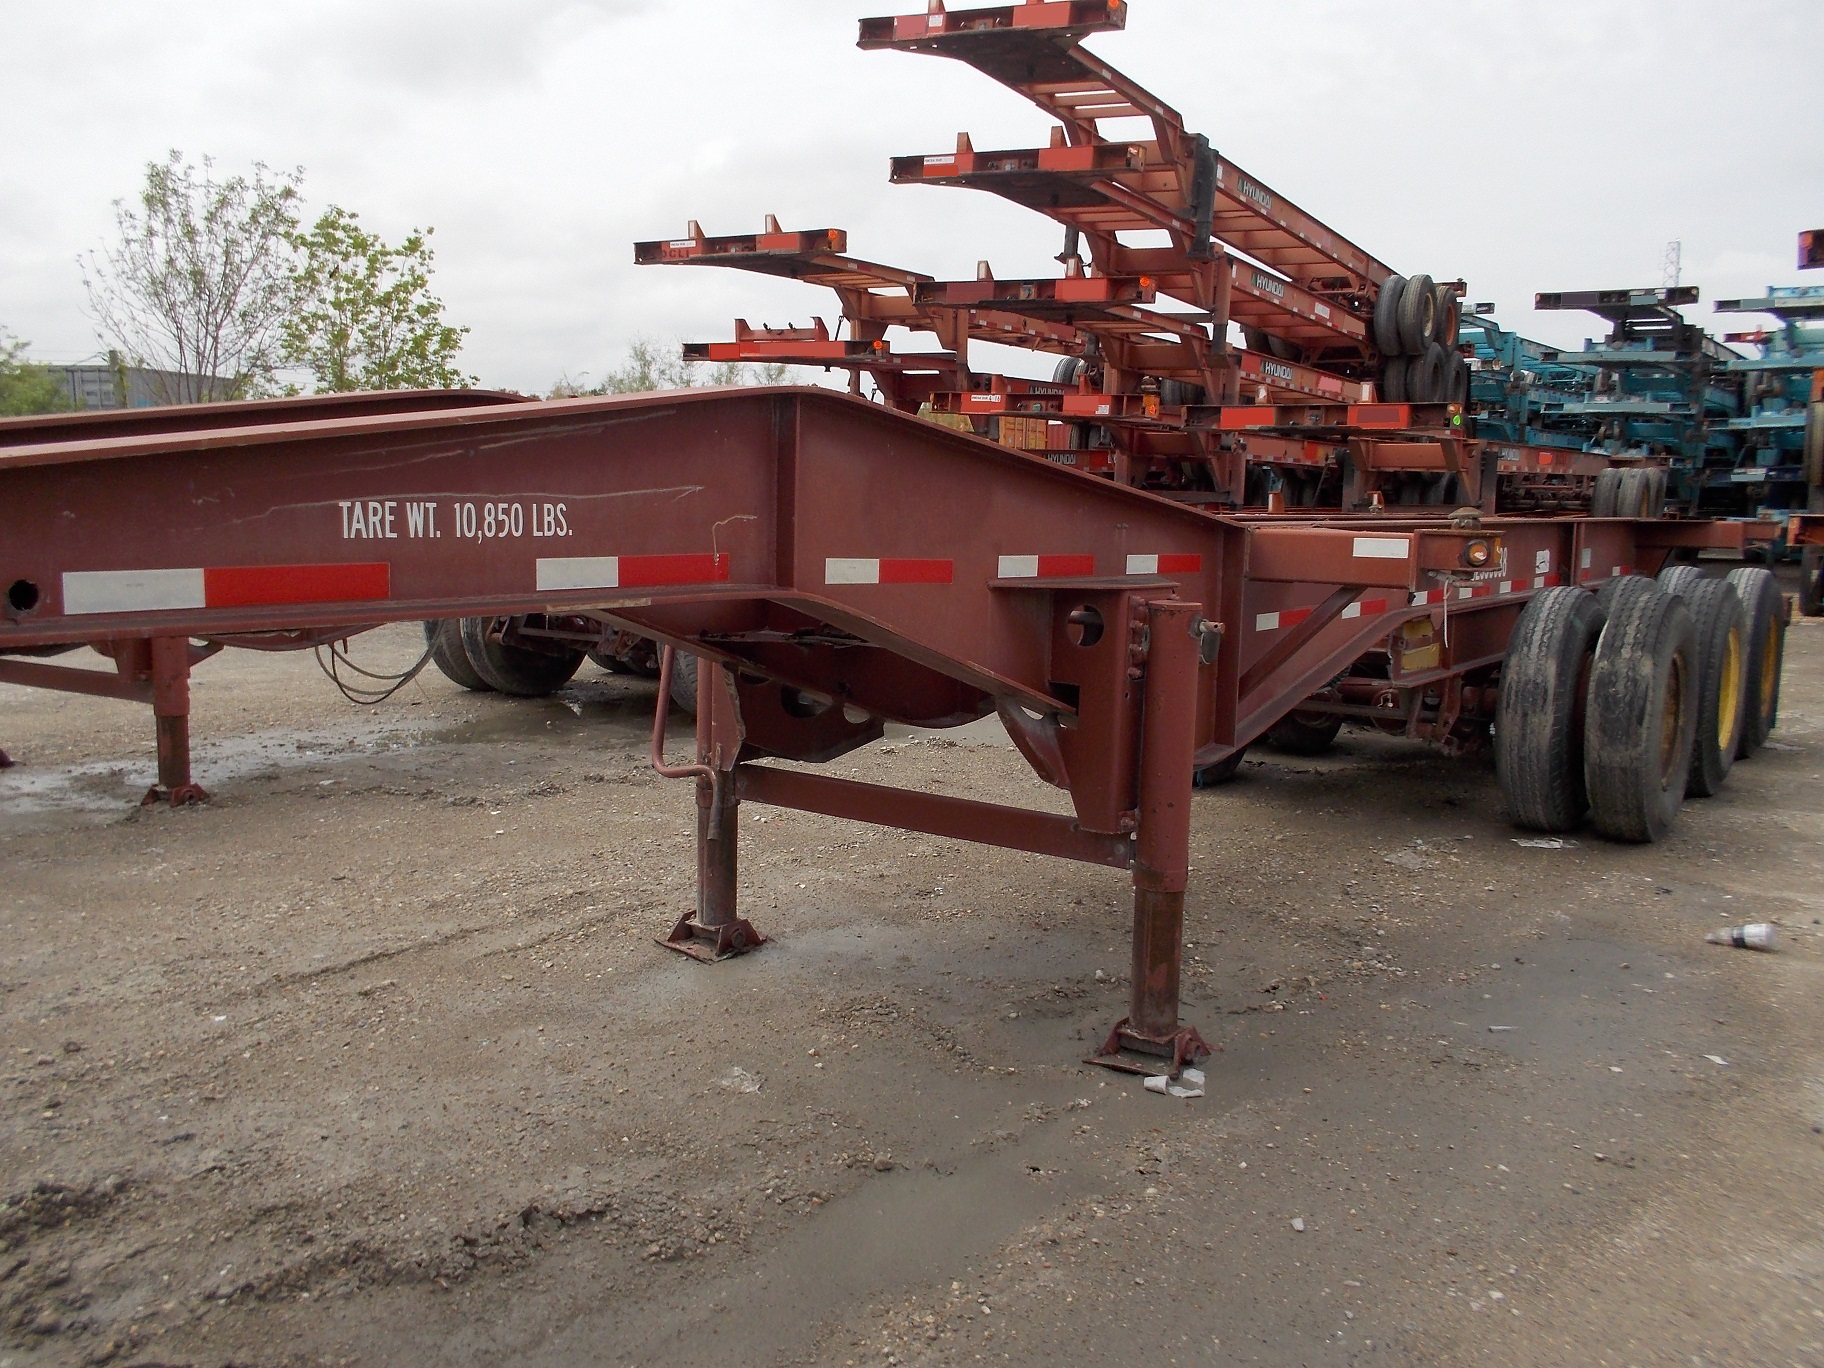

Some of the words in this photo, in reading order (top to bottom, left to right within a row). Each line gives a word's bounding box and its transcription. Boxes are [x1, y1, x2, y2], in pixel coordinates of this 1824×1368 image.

[1243, 180, 1272, 210] HYUNDAI
[1256, 274, 1285, 298] HYUNDAI
[1265, 361, 1293, 380] HYUNDAI
[339, 501, 398, 539] TARE
[406, 502, 441, 538] WT.
[454, 502, 524, 544] 10,850
[532, 503, 574, 538] LBS.
